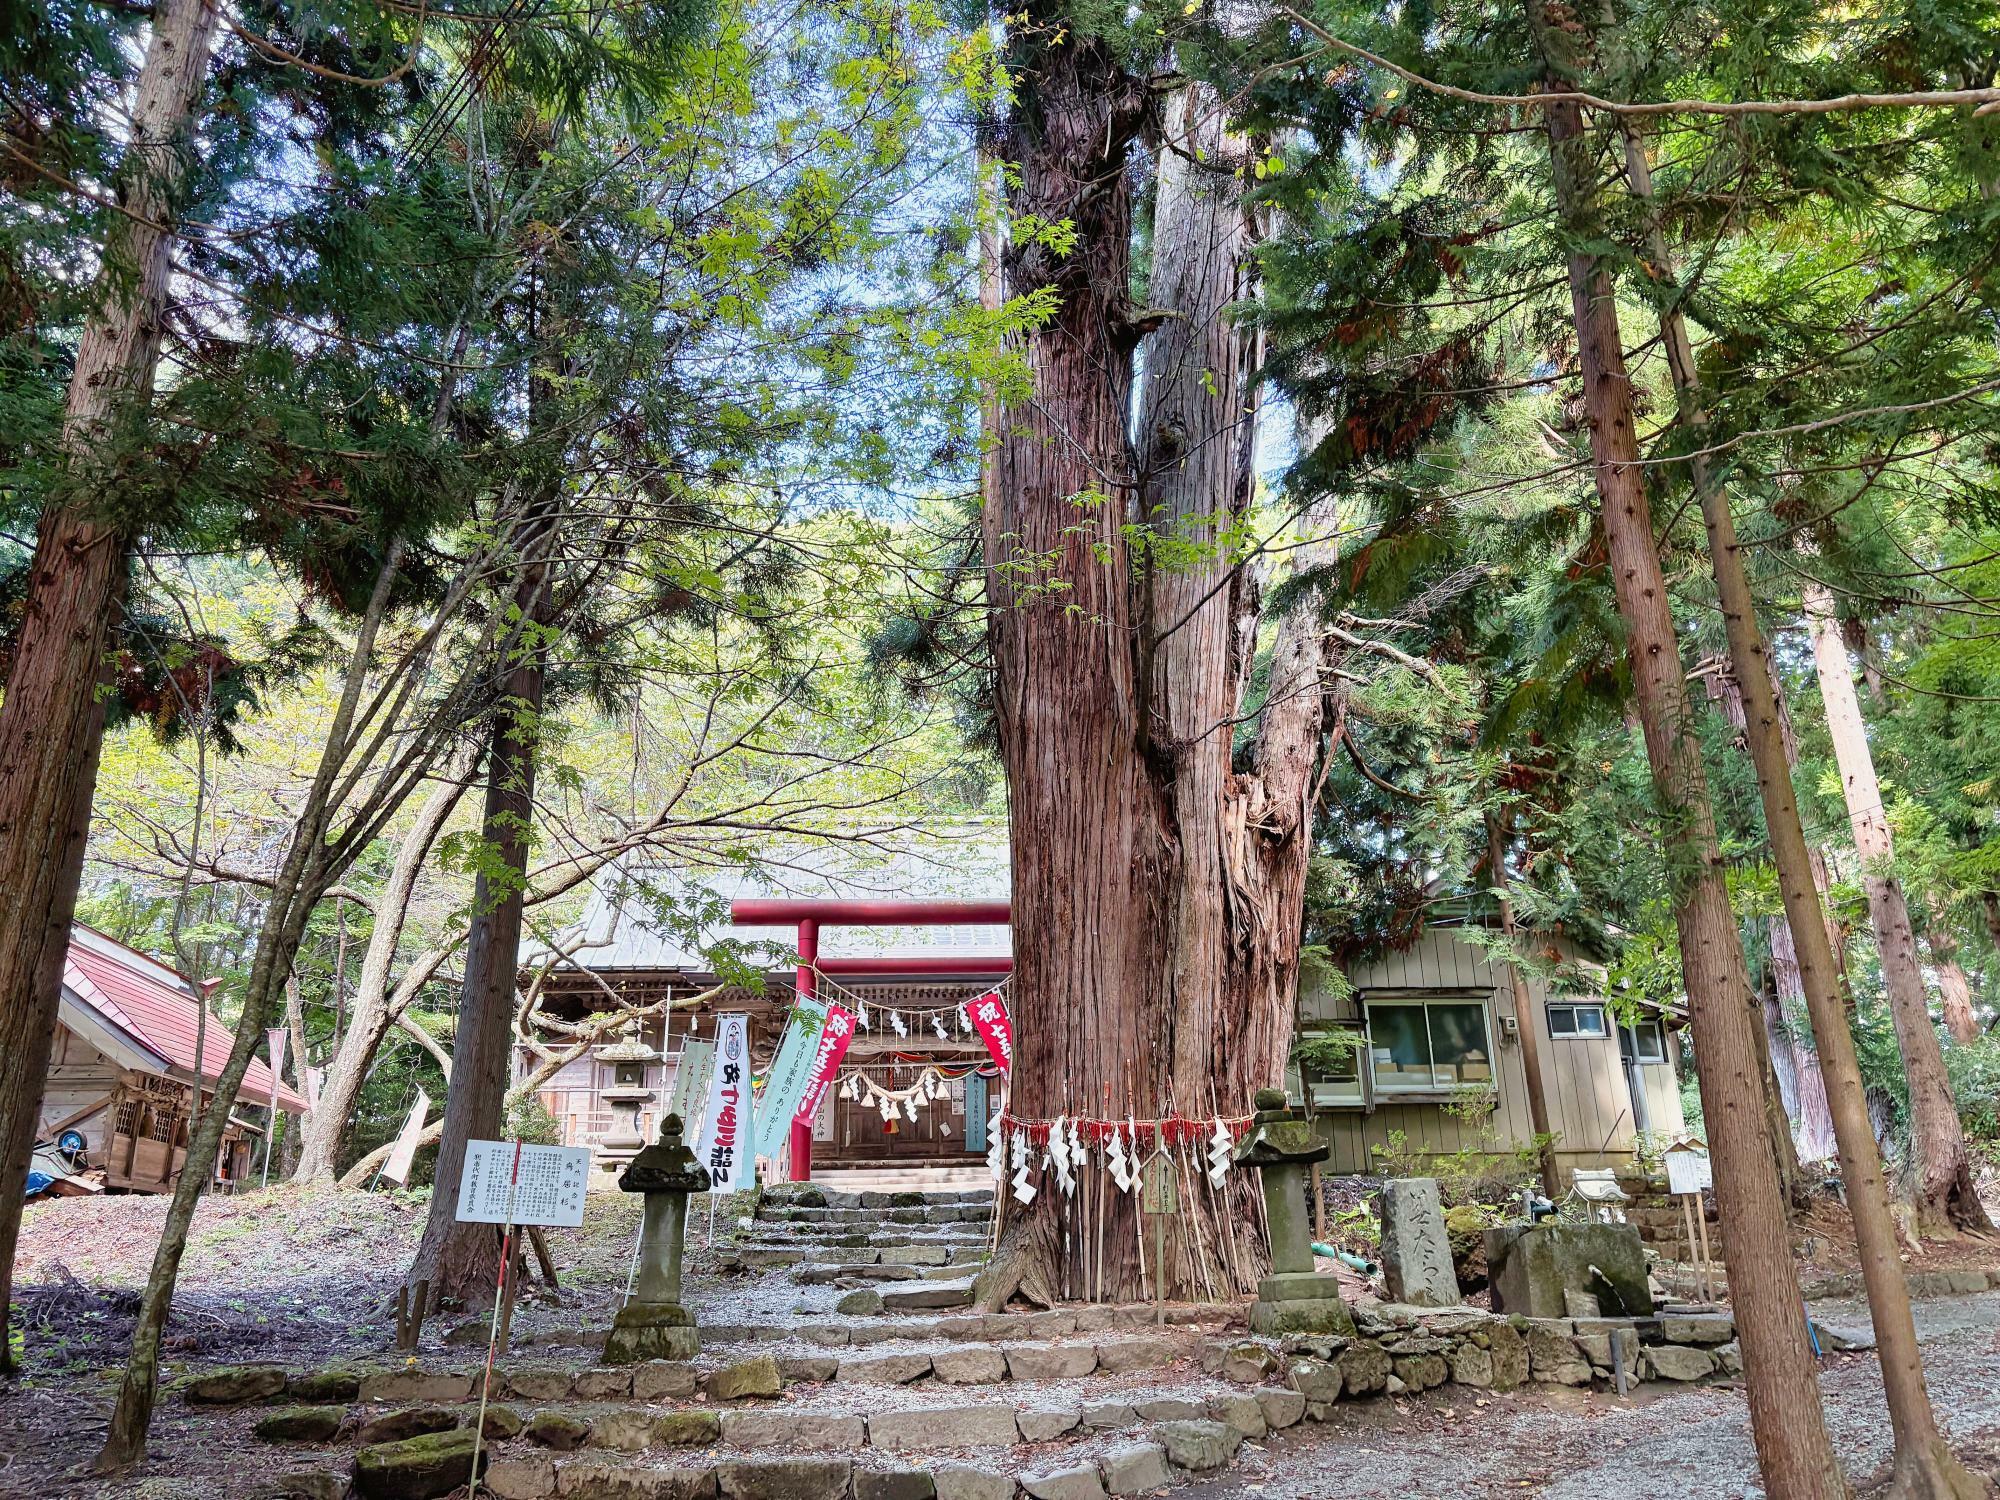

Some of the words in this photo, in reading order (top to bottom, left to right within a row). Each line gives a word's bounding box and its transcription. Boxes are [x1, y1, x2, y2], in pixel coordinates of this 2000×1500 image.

[560, 1161, 574, 1206] 鳥居杉
[570, 1157, 583, 1212] 天然記念物
